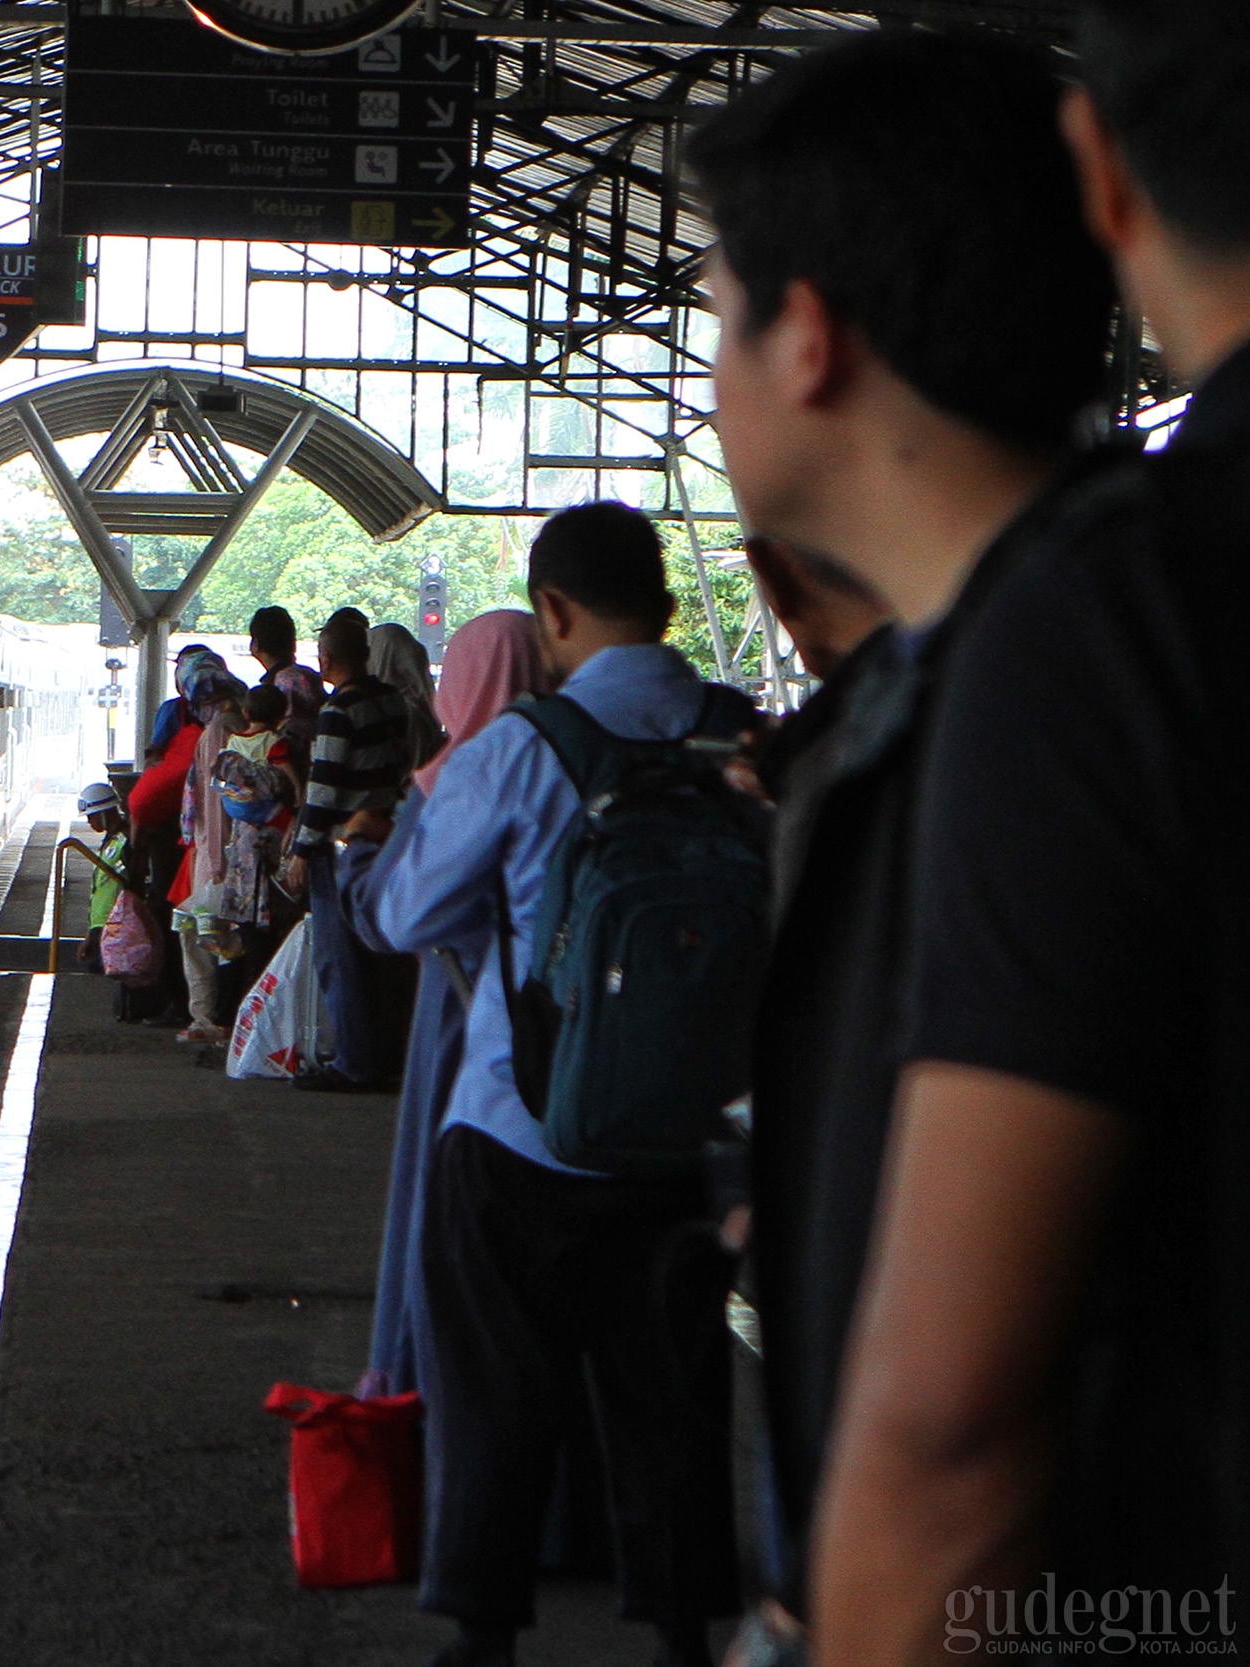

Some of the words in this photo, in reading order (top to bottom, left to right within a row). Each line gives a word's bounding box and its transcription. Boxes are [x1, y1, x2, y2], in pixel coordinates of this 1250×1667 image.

[266, 89, 329, 108] Toilet
[187, 138, 239, 156] Area
[251, 140, 330, 165] Tunggu
[252, 197, 326, 218] Keluar
